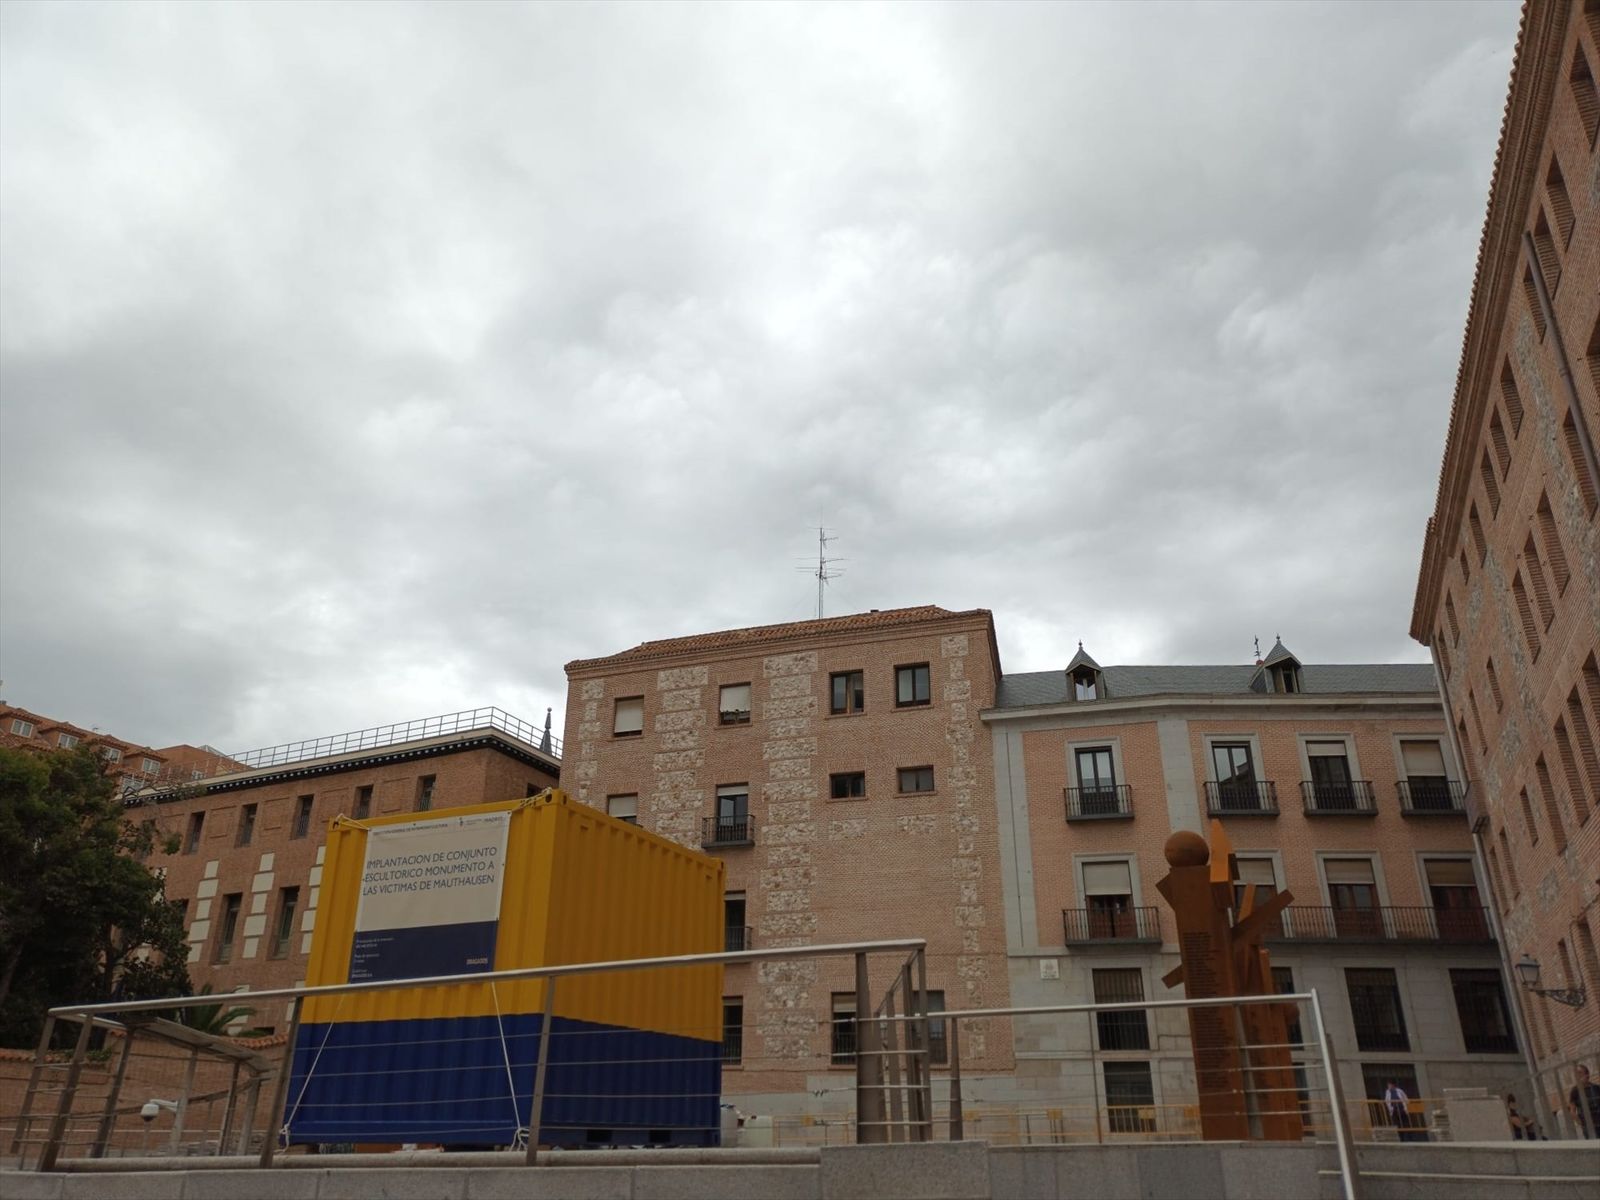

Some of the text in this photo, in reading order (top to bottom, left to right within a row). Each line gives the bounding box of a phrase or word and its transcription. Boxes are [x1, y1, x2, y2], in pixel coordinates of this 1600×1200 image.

[367, 847, 497, 869] IMPLANTACION DE CONJUNTO
[365, 861, 495, 882] ESCULTORICO MONUMENTO A
[362, 874, 495, 896] LAS VICTIMAS DE MAUTHAUSEN
